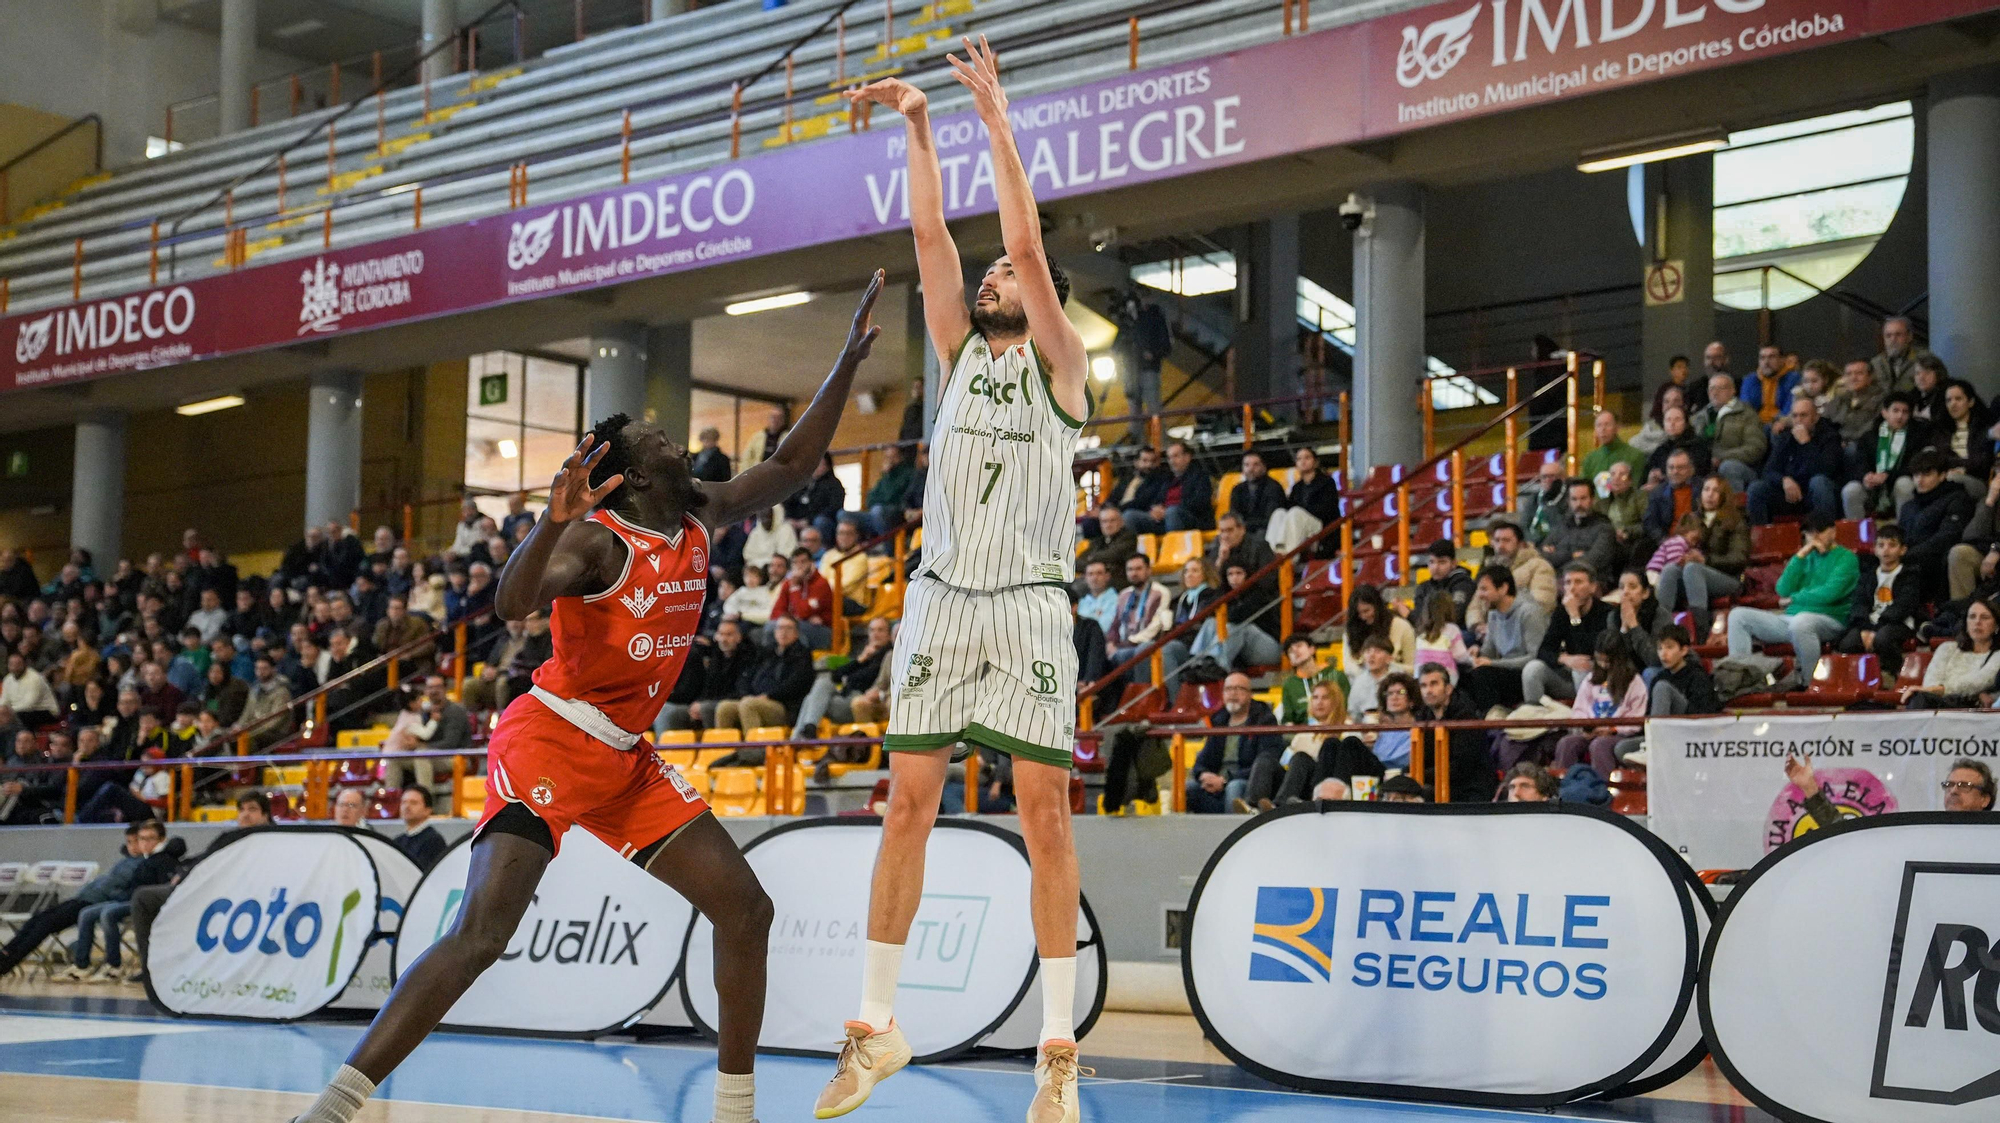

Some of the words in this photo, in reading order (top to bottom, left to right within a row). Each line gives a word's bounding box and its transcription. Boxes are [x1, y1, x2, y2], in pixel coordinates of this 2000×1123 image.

[1491, 0, 1767, 67] IMD
[1397, 91, 1480, 123] Instituto
[1483, 64, 1587, 103] Municipal
[1591, 60, 1621, 82] de
[1627, 37, 1734, 77] Deportes
[1737, 14, 1845, 52] Córdoba
[887, 120, 974, 160] PACIO
[976, 94, 1092, 141] MNICIPAL
[1101, 66, 1212, 114] DEPORTES
[864, 150, 998, 226] VITA
[1028, 95, 1247, 190] ALEGRE
[561, 169, 755, 259] IMDECO
[507, 275, 557, 296] Instituto
[558, 259, 617, 287] Municipal
[617, 257, 635, 275] de
[635, 247, 695, 273] Deportes
[55, 286, 195, 356] IMDECO
[951, 424, 993, 439] Fundación
[998, 427, 1035, 444] Cajasol
[980, 462, 1003, 505] 7
[656, 581, 683, 595] CAJA
[656, 648, 674, 657] LEÓN
[1685, 735, 1855, 758] INVESTIGACIÓN
[1878, 734, 1999, 757] SOLUCIÓN
[196, 887, 323, 959] coto
[779, 914, 859, 939] ÍNICA
[915, 911, 967, 963] TÚ
[1355, 888, 1611, 949] REALE
[1351, 951, 1609, 1001] SEGUROS
